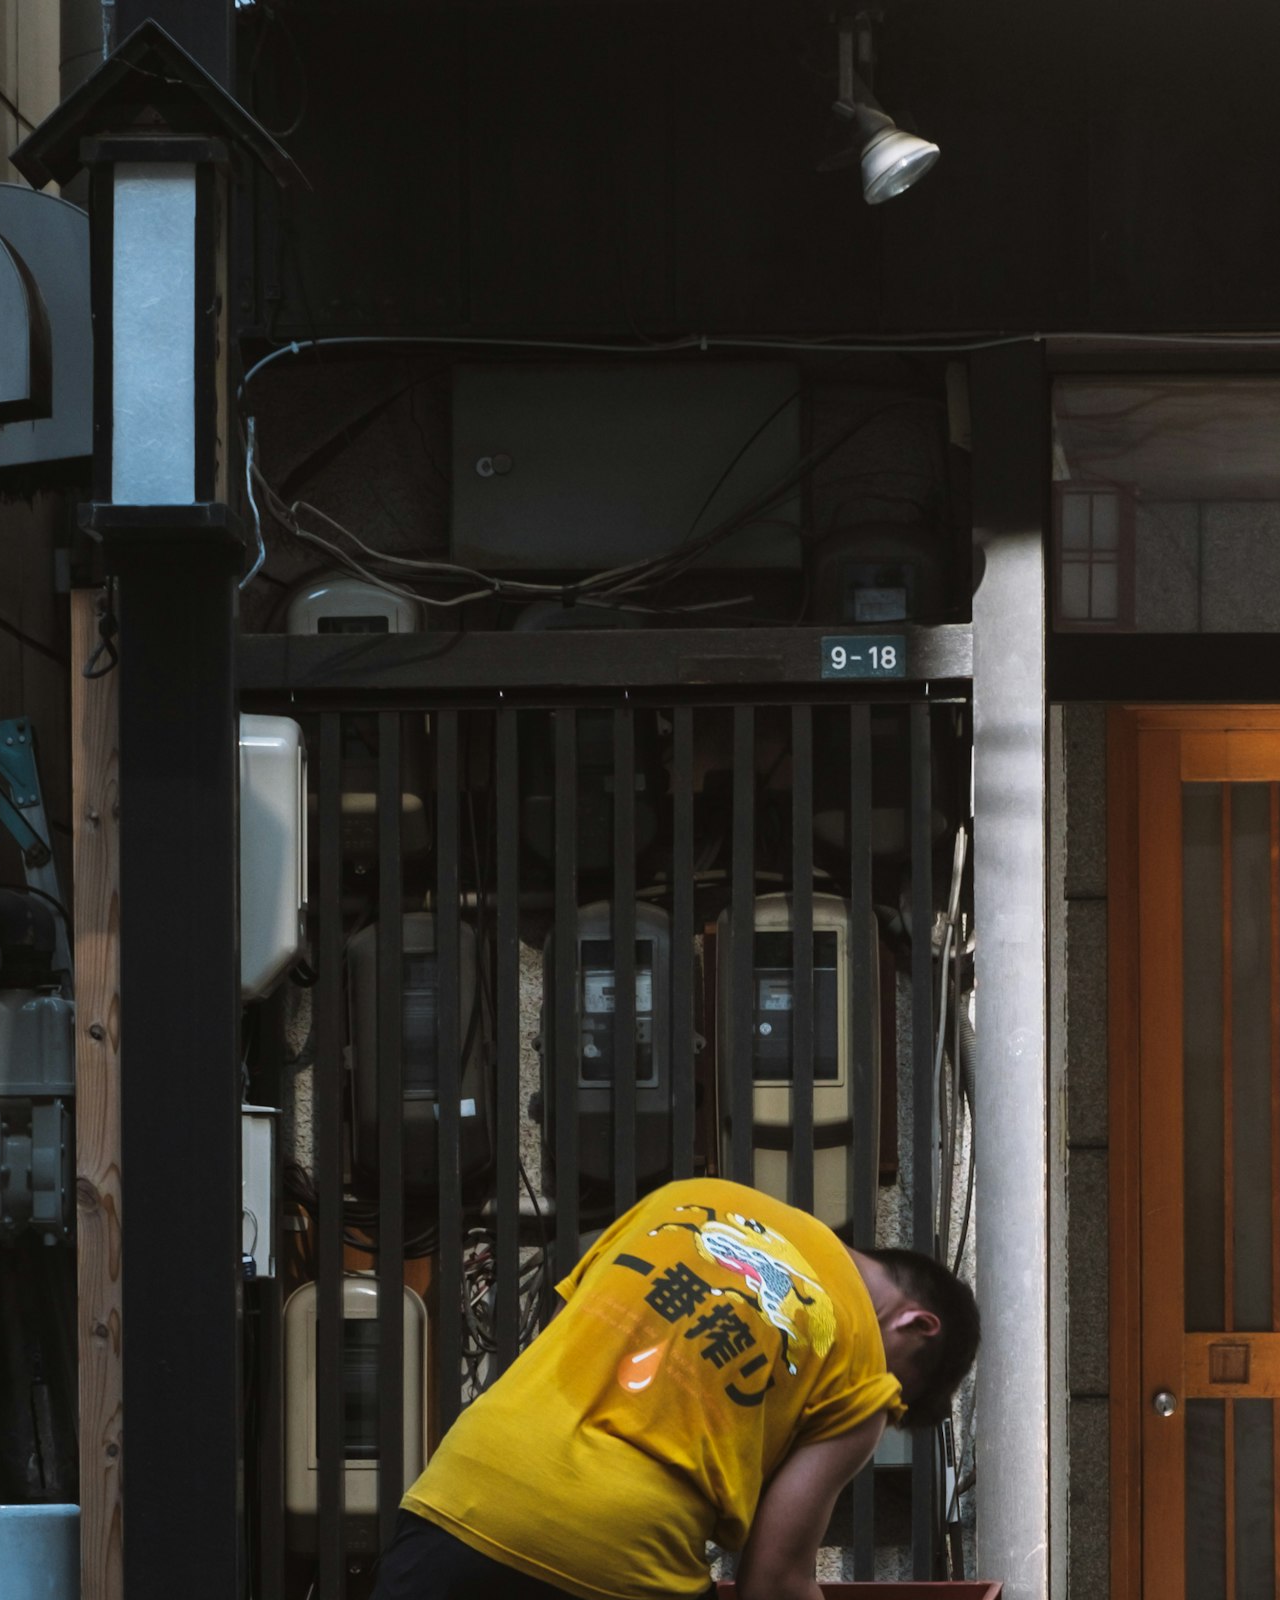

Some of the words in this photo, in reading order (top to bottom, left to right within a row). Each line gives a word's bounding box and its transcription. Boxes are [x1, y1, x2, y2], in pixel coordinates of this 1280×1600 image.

[831, 645, 897, 670] 9-18
[612, 1253, 775, 1408] 一番搾り
